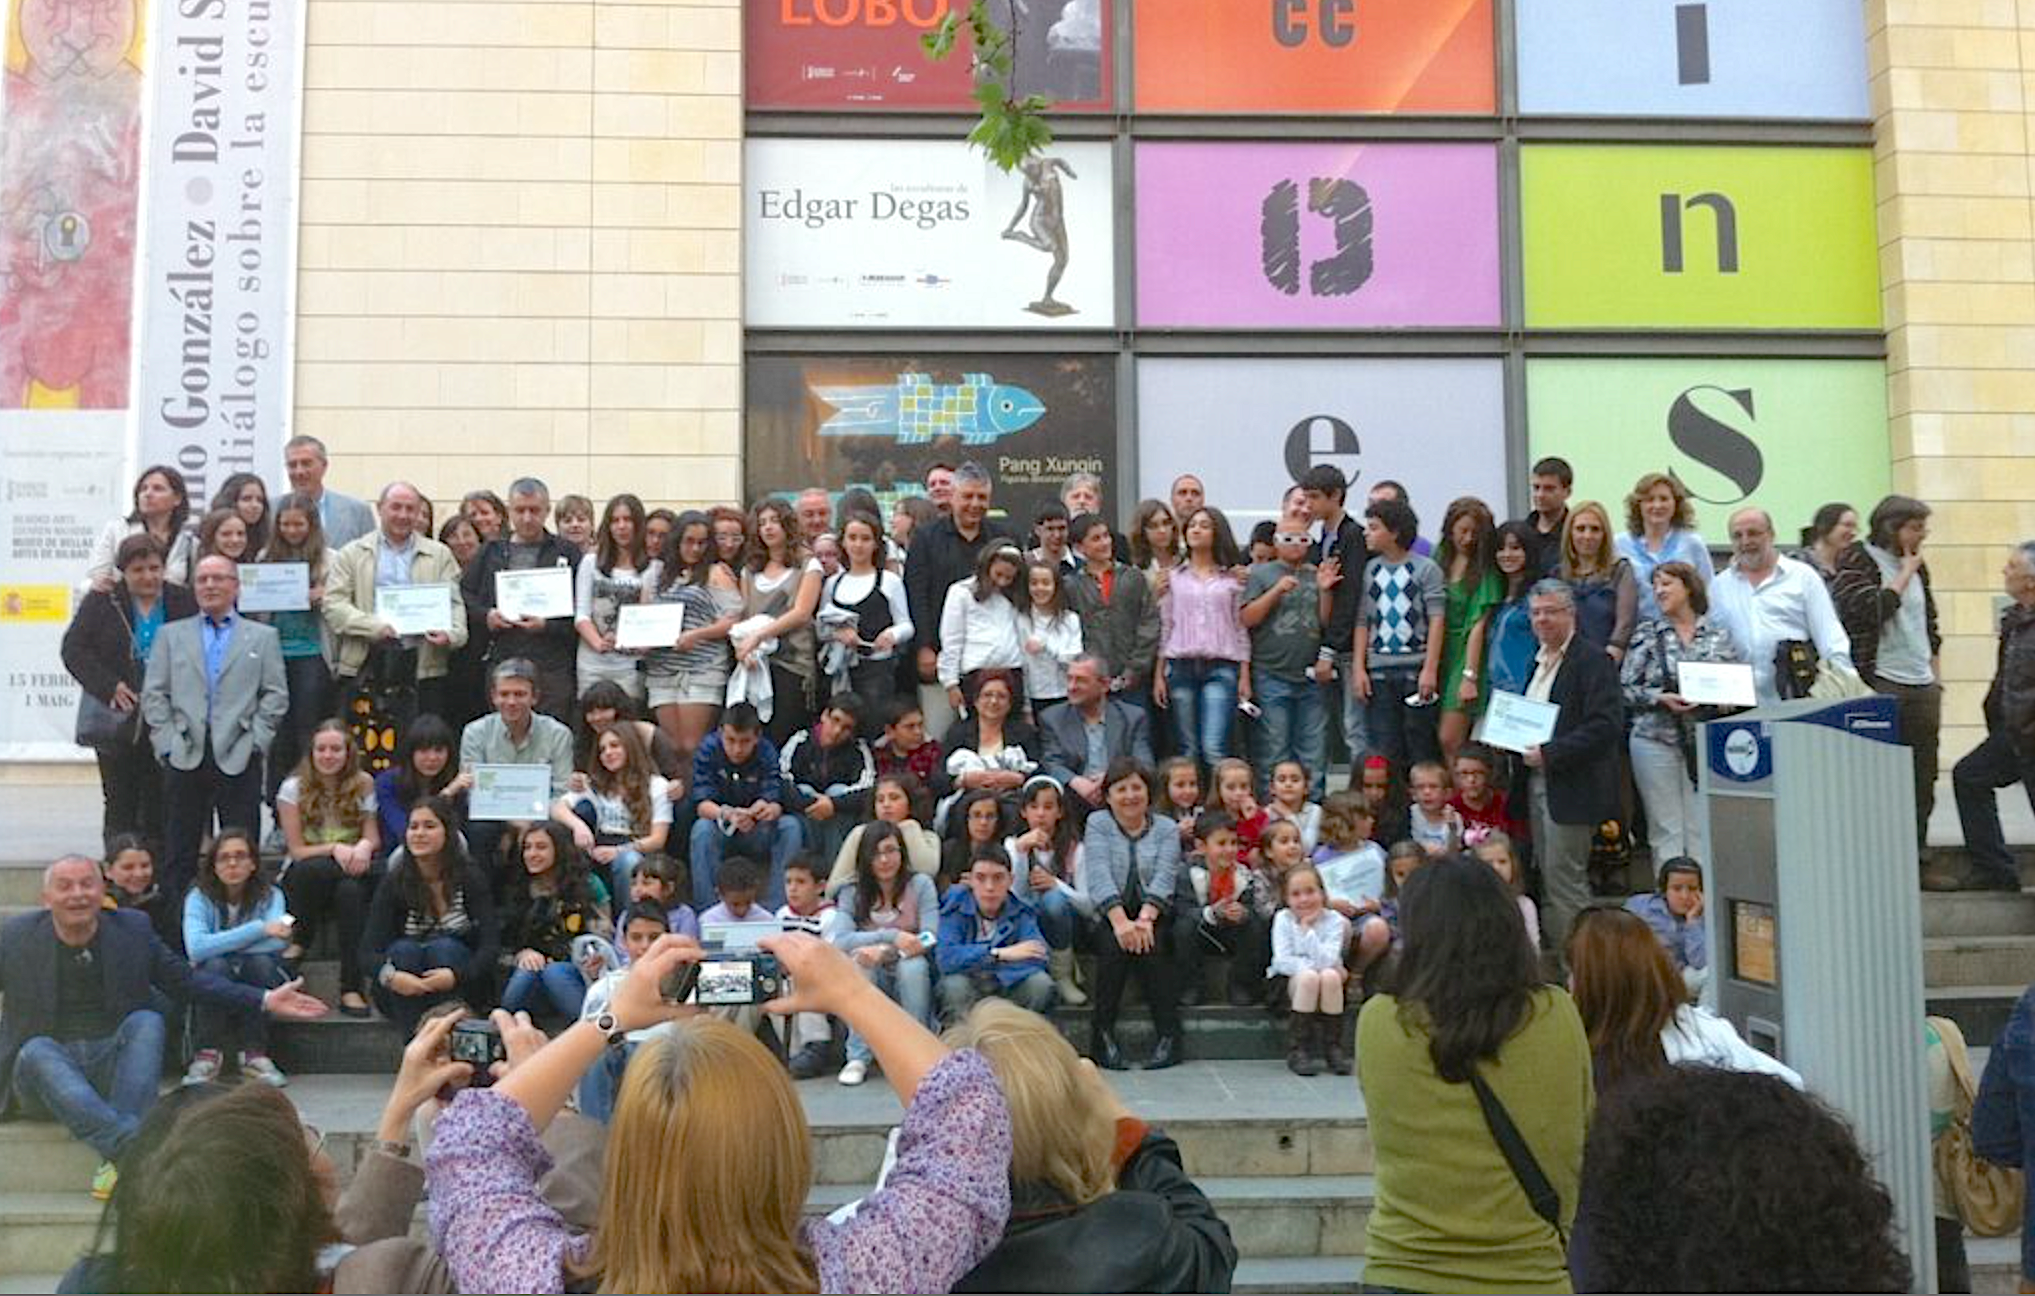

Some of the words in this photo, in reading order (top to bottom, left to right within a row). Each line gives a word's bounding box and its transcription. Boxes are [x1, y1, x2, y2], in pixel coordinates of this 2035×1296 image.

[172, 36, 223, 164] David
[230, 112, 266, 149] la
[226, 169, 263, 292] sobre
[757, 189, 858, 229] Edgar
[869, 191, 970, 230] Degas
[1660, 191, 1739, 273] n
[161, 220, 216, 429] González
[999, 456, 1041, 474] Pang
[1046, 456, 1103, 473] Xunqin
[1284, 414, 1361, 488] e
[9, 673, 26, 687] 15
